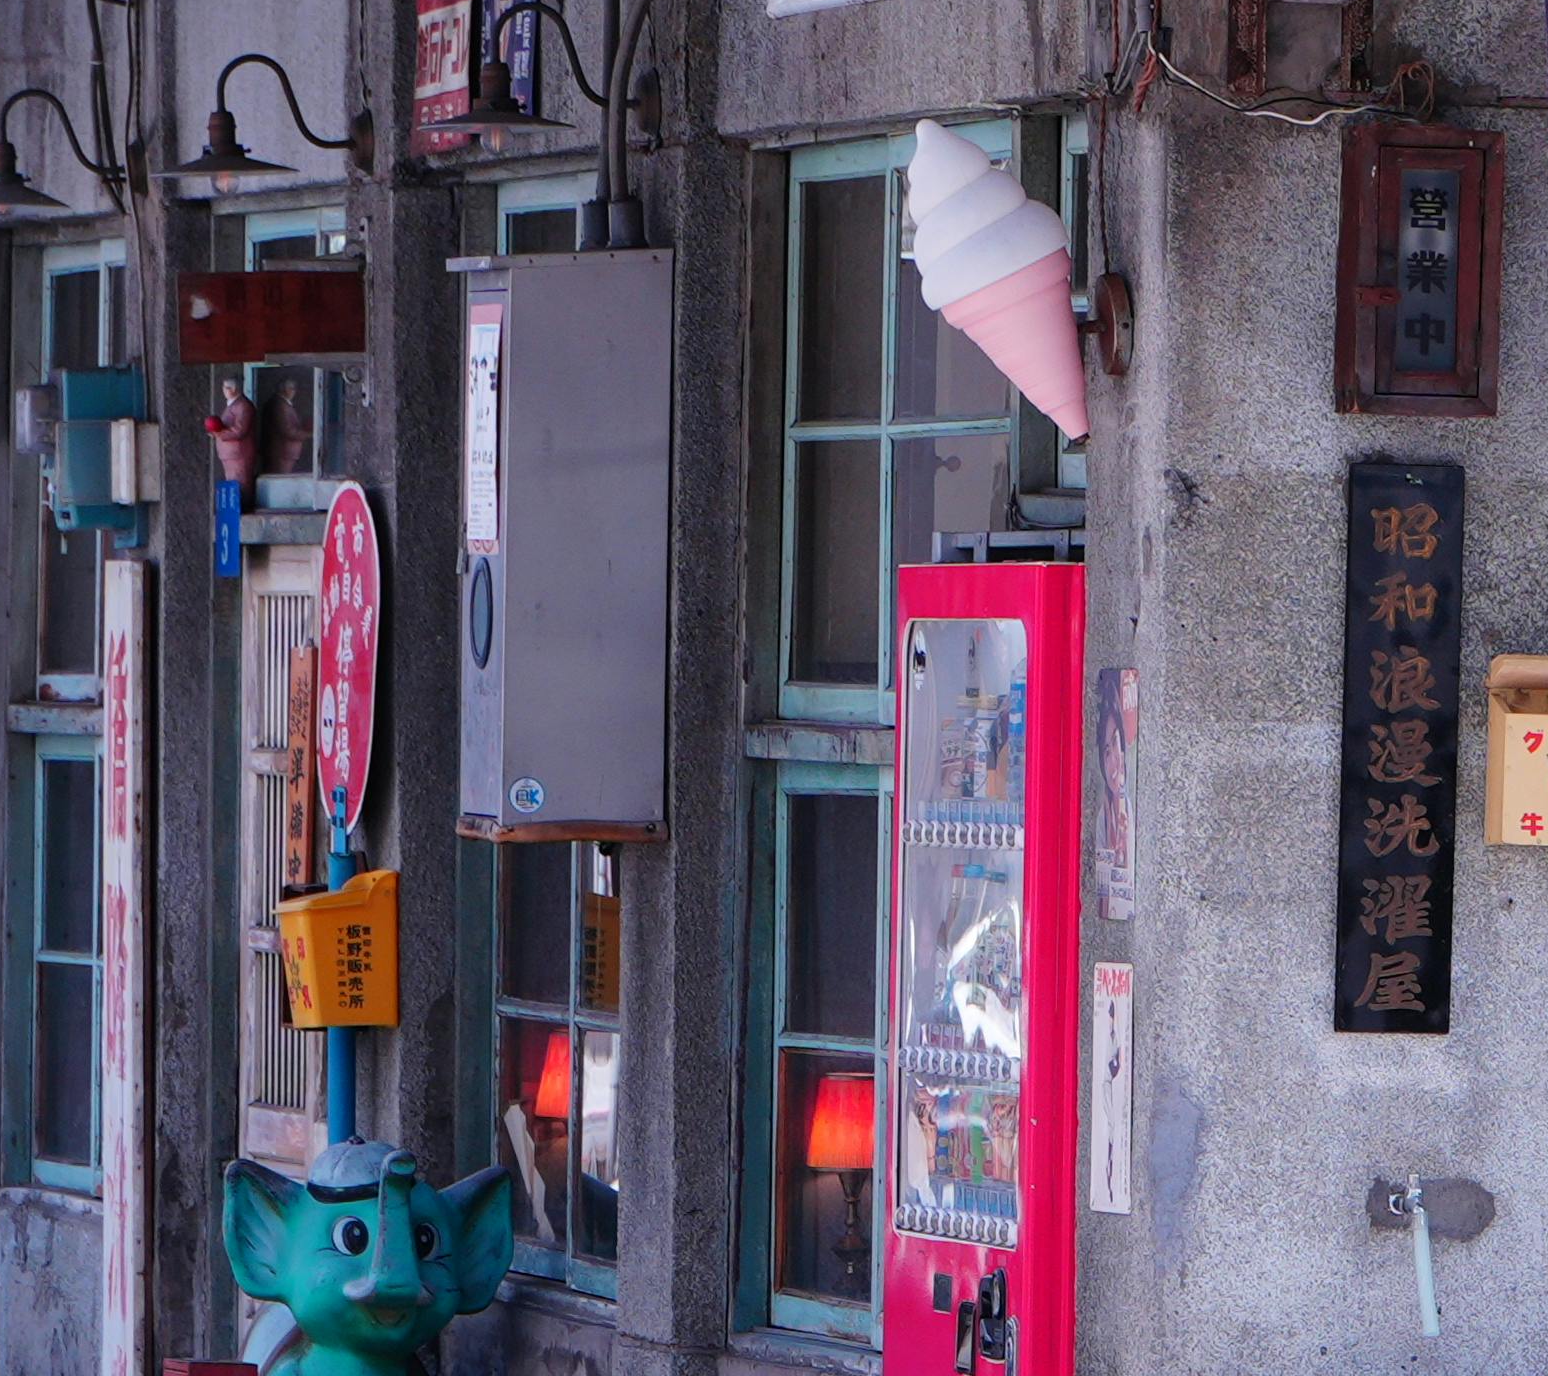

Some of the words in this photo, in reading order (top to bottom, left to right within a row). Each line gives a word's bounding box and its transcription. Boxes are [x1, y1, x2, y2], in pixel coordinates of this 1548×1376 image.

[1356, 501, 1443, 1015] 昭和浪漫洗濯屋
